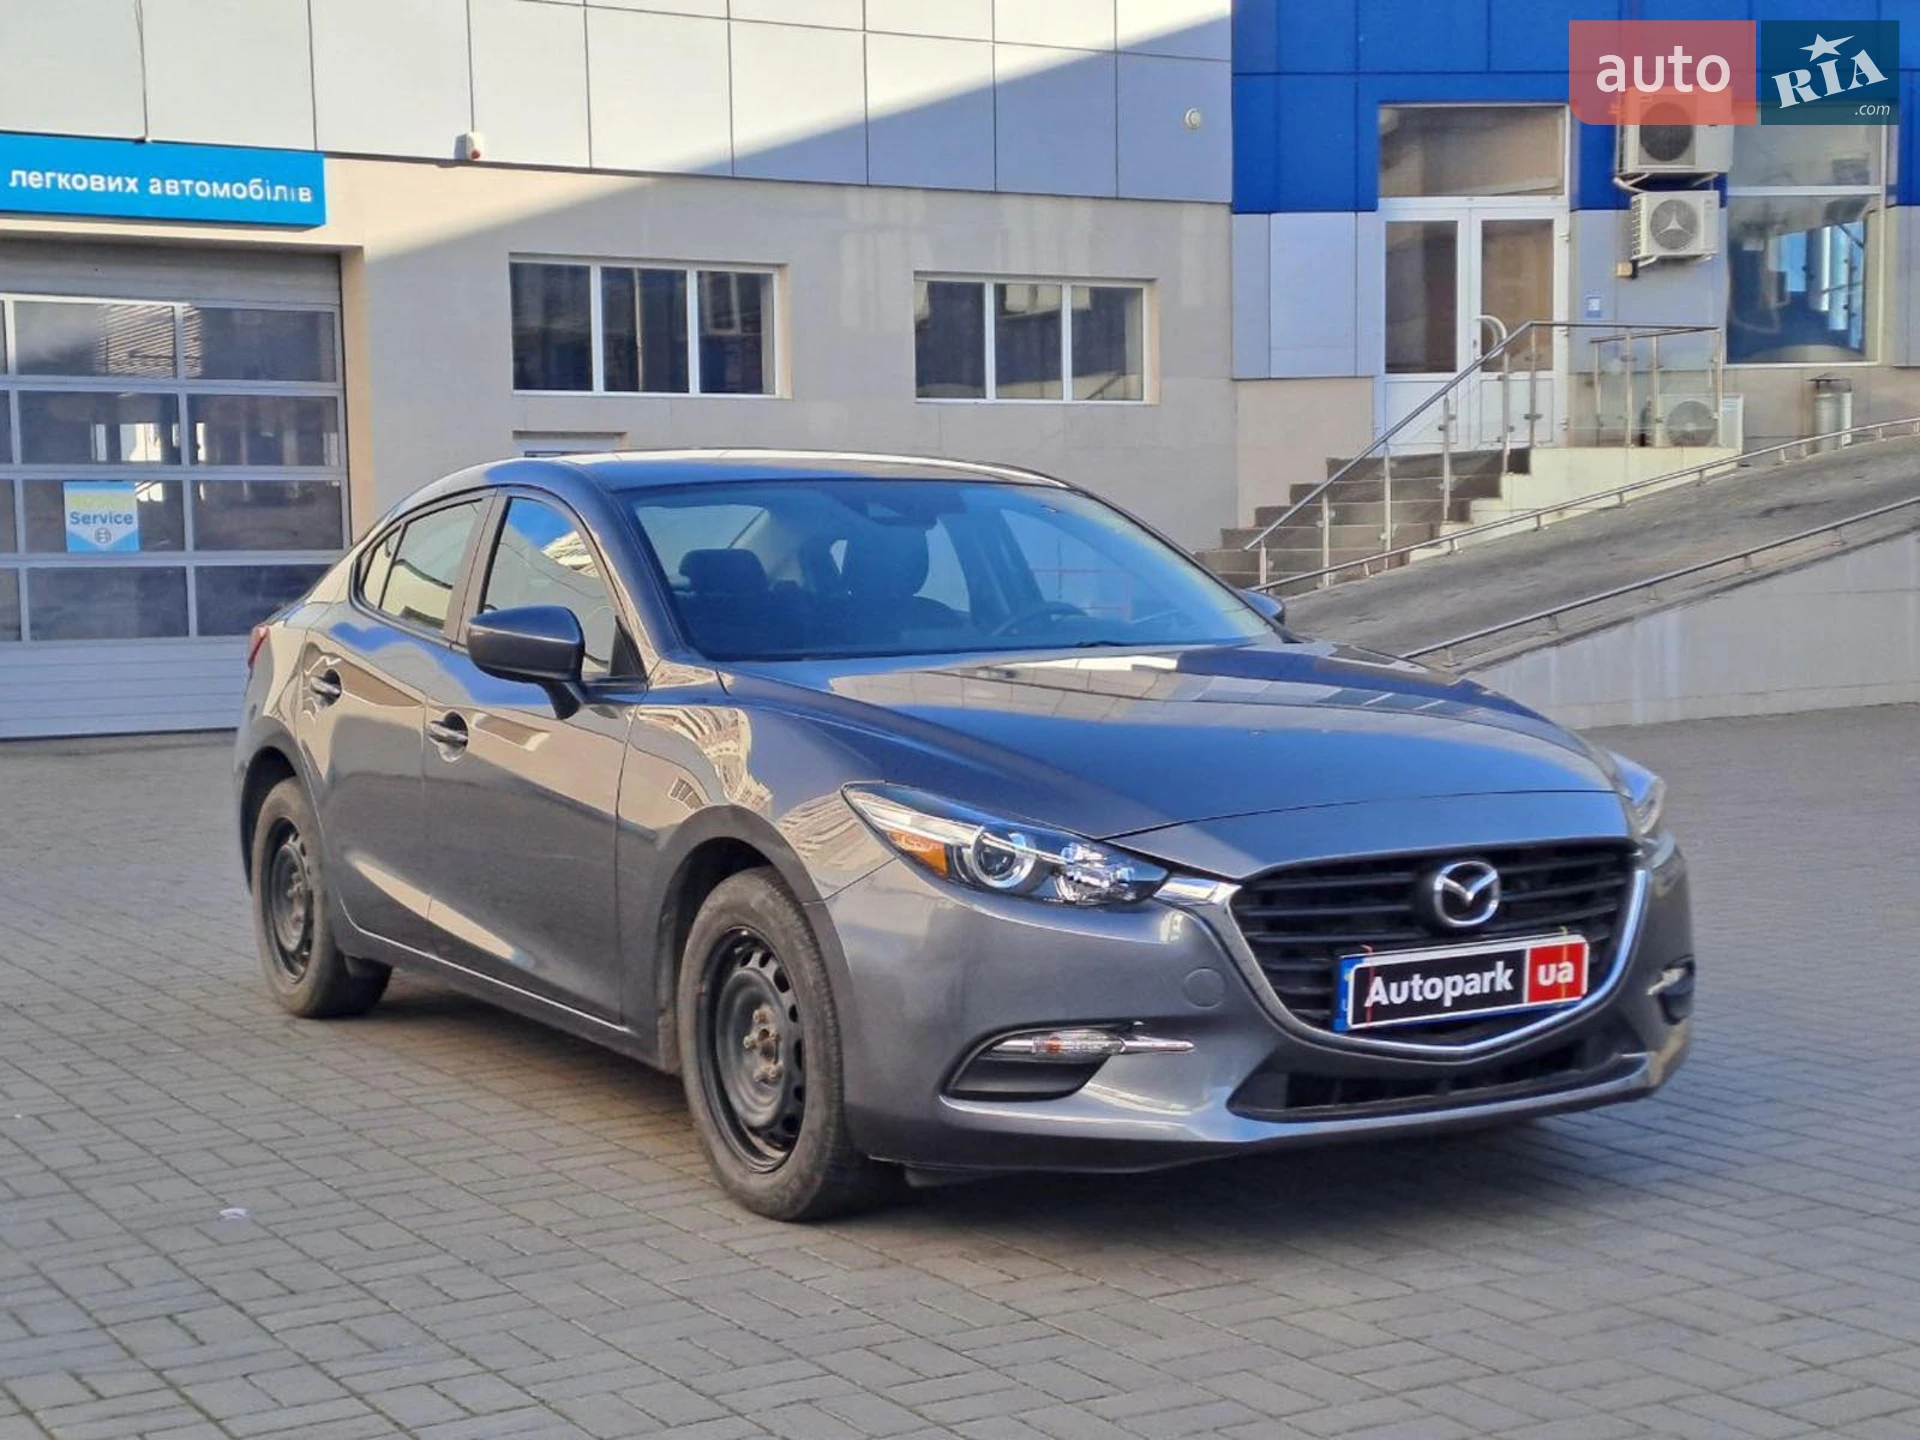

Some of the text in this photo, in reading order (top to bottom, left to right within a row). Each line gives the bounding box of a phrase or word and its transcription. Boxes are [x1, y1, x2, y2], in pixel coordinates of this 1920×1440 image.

[9, 168, 312, 203] легкових автомобілів
[70, 511, 134, 525] Service
[1364, 961, 1513, 1007] Autopark
[1537, 961, 1575, 986] ua
